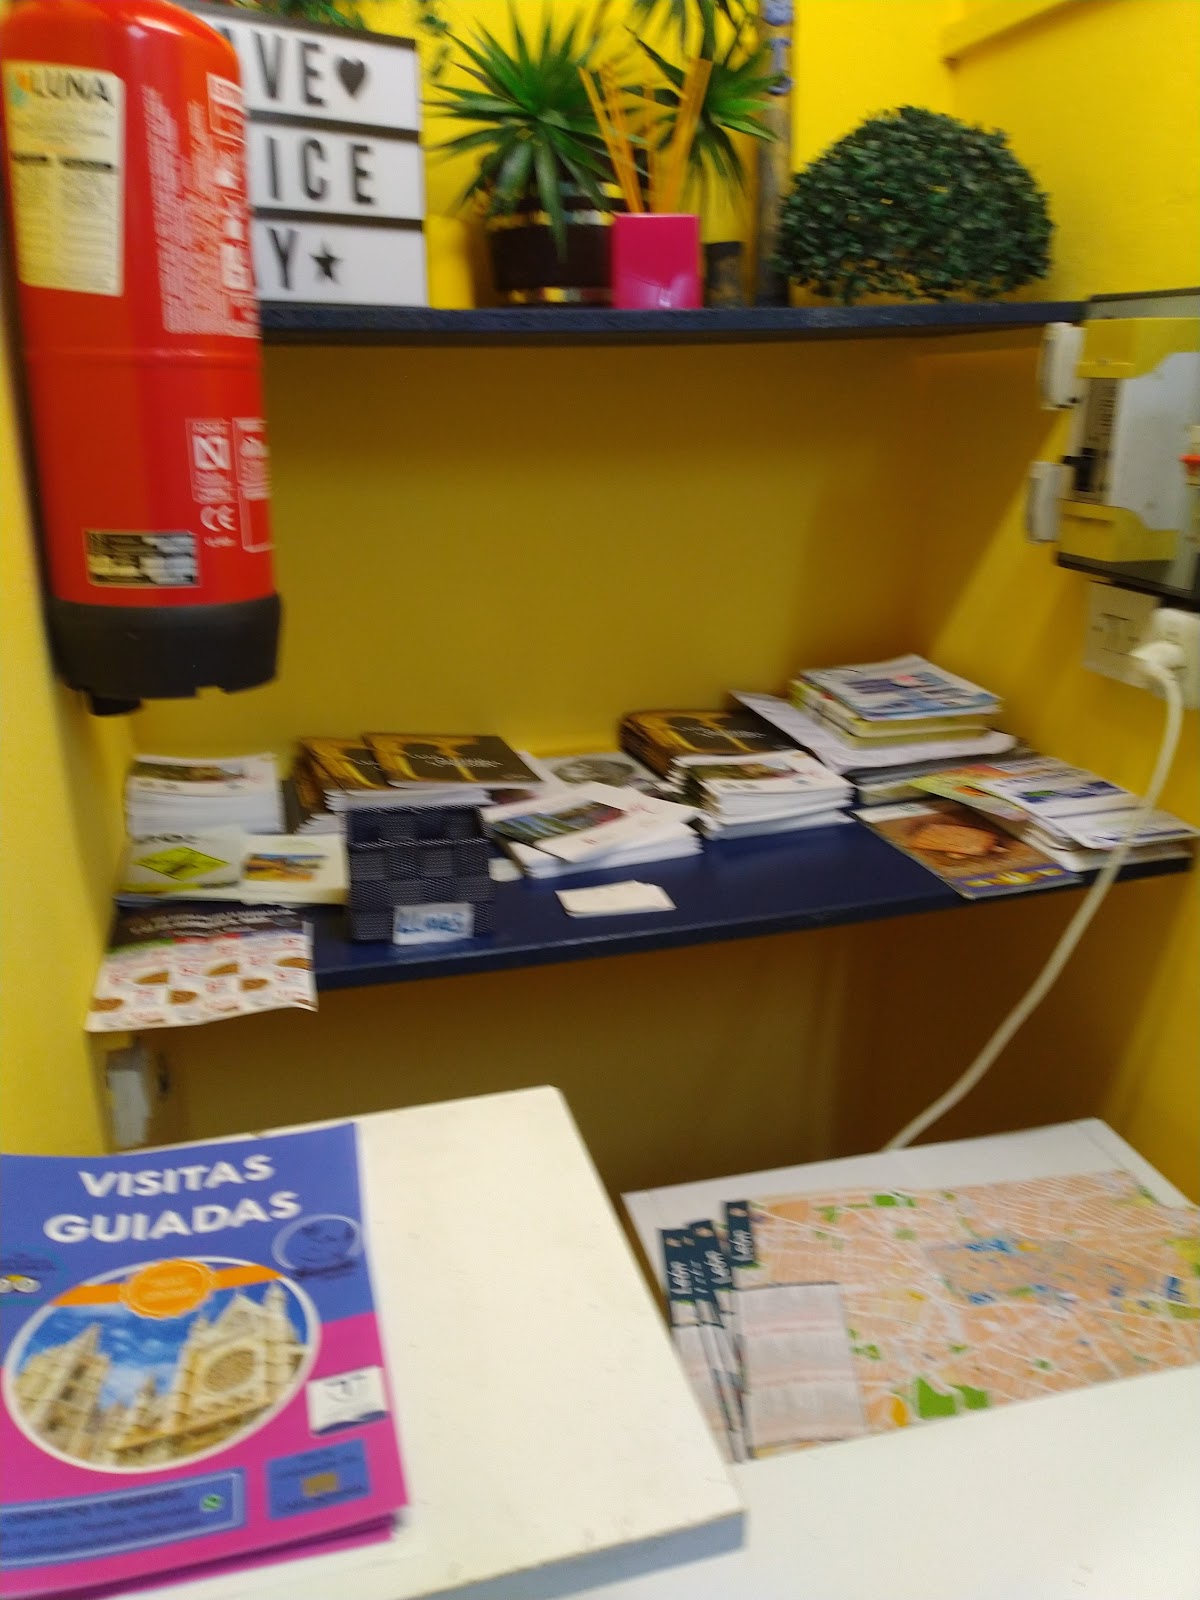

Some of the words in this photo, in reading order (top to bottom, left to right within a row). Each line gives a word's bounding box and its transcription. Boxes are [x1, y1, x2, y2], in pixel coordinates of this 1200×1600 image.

[29, 69, 114, 107] LUNA
[78, 1154, 276, 1197] VISITAS
[43, 1191, 302, 1243] GUIADAS
